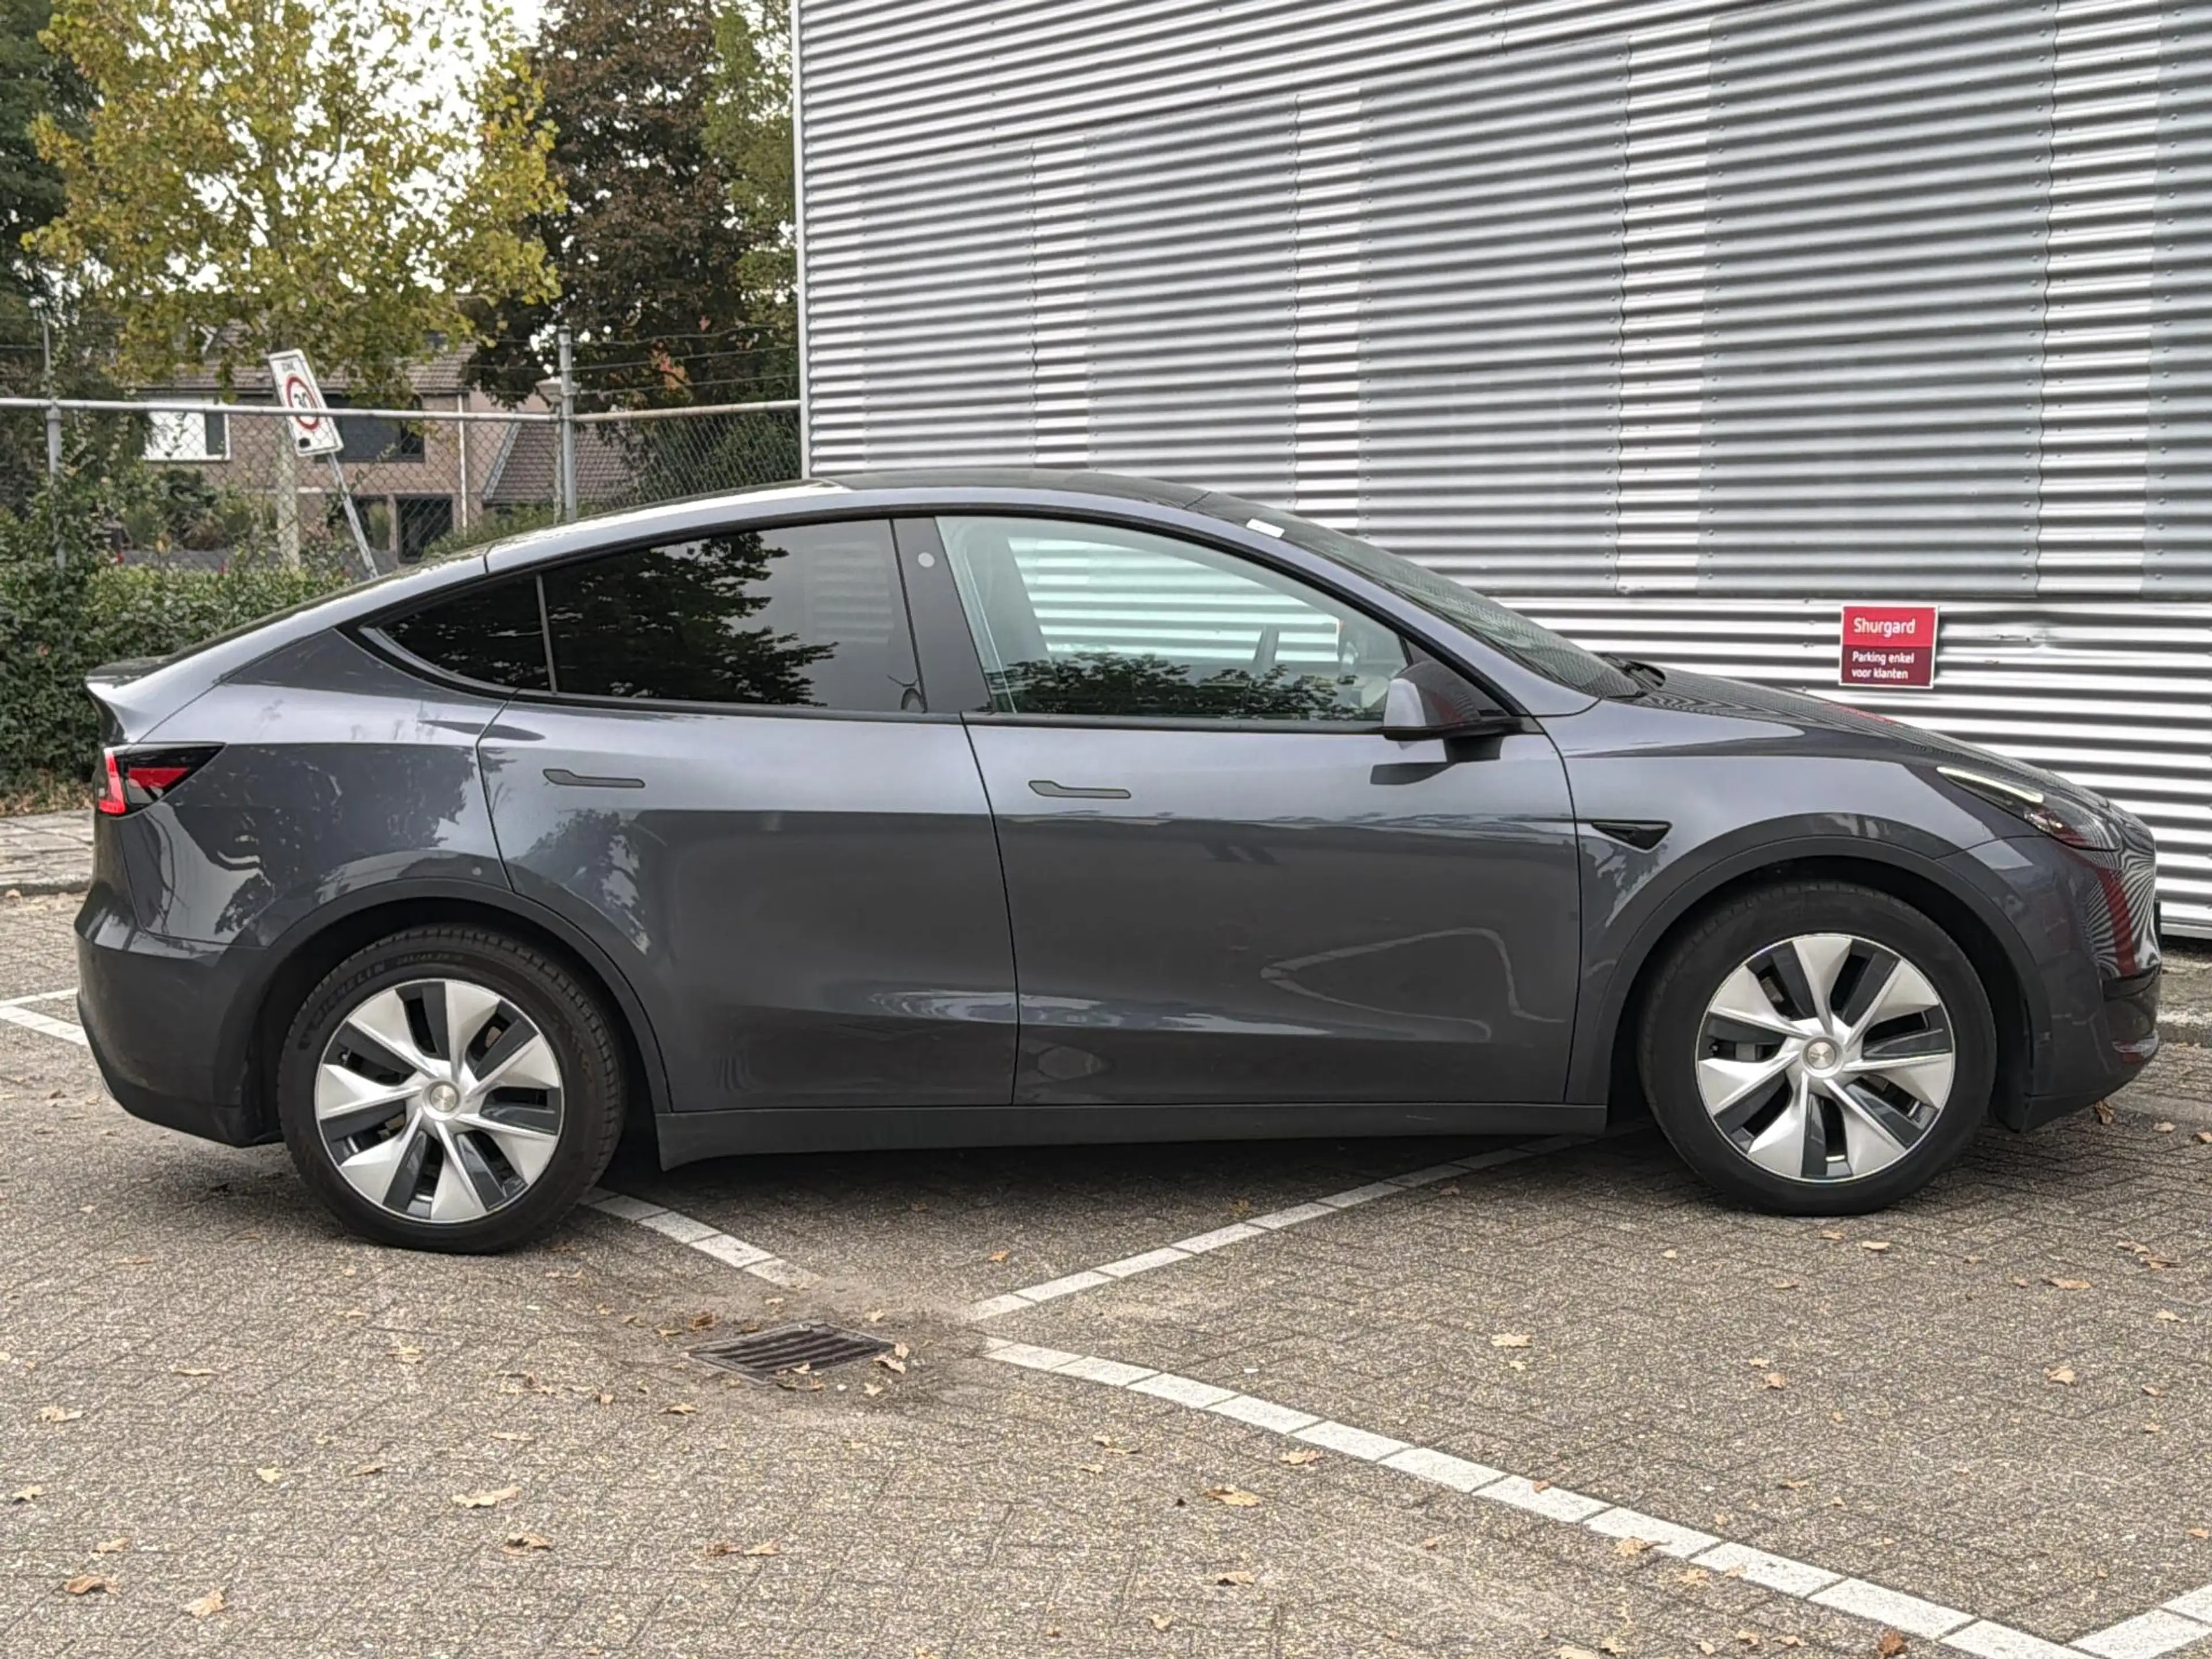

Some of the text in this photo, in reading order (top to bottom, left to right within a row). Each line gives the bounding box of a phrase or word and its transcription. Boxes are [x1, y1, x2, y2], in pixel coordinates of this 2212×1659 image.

[1853, 617, 1916, 638] Shurgard
[1852, 651, 1915, 665] Parking enkel
[1851, 668, 1908, 679] voor klanten
